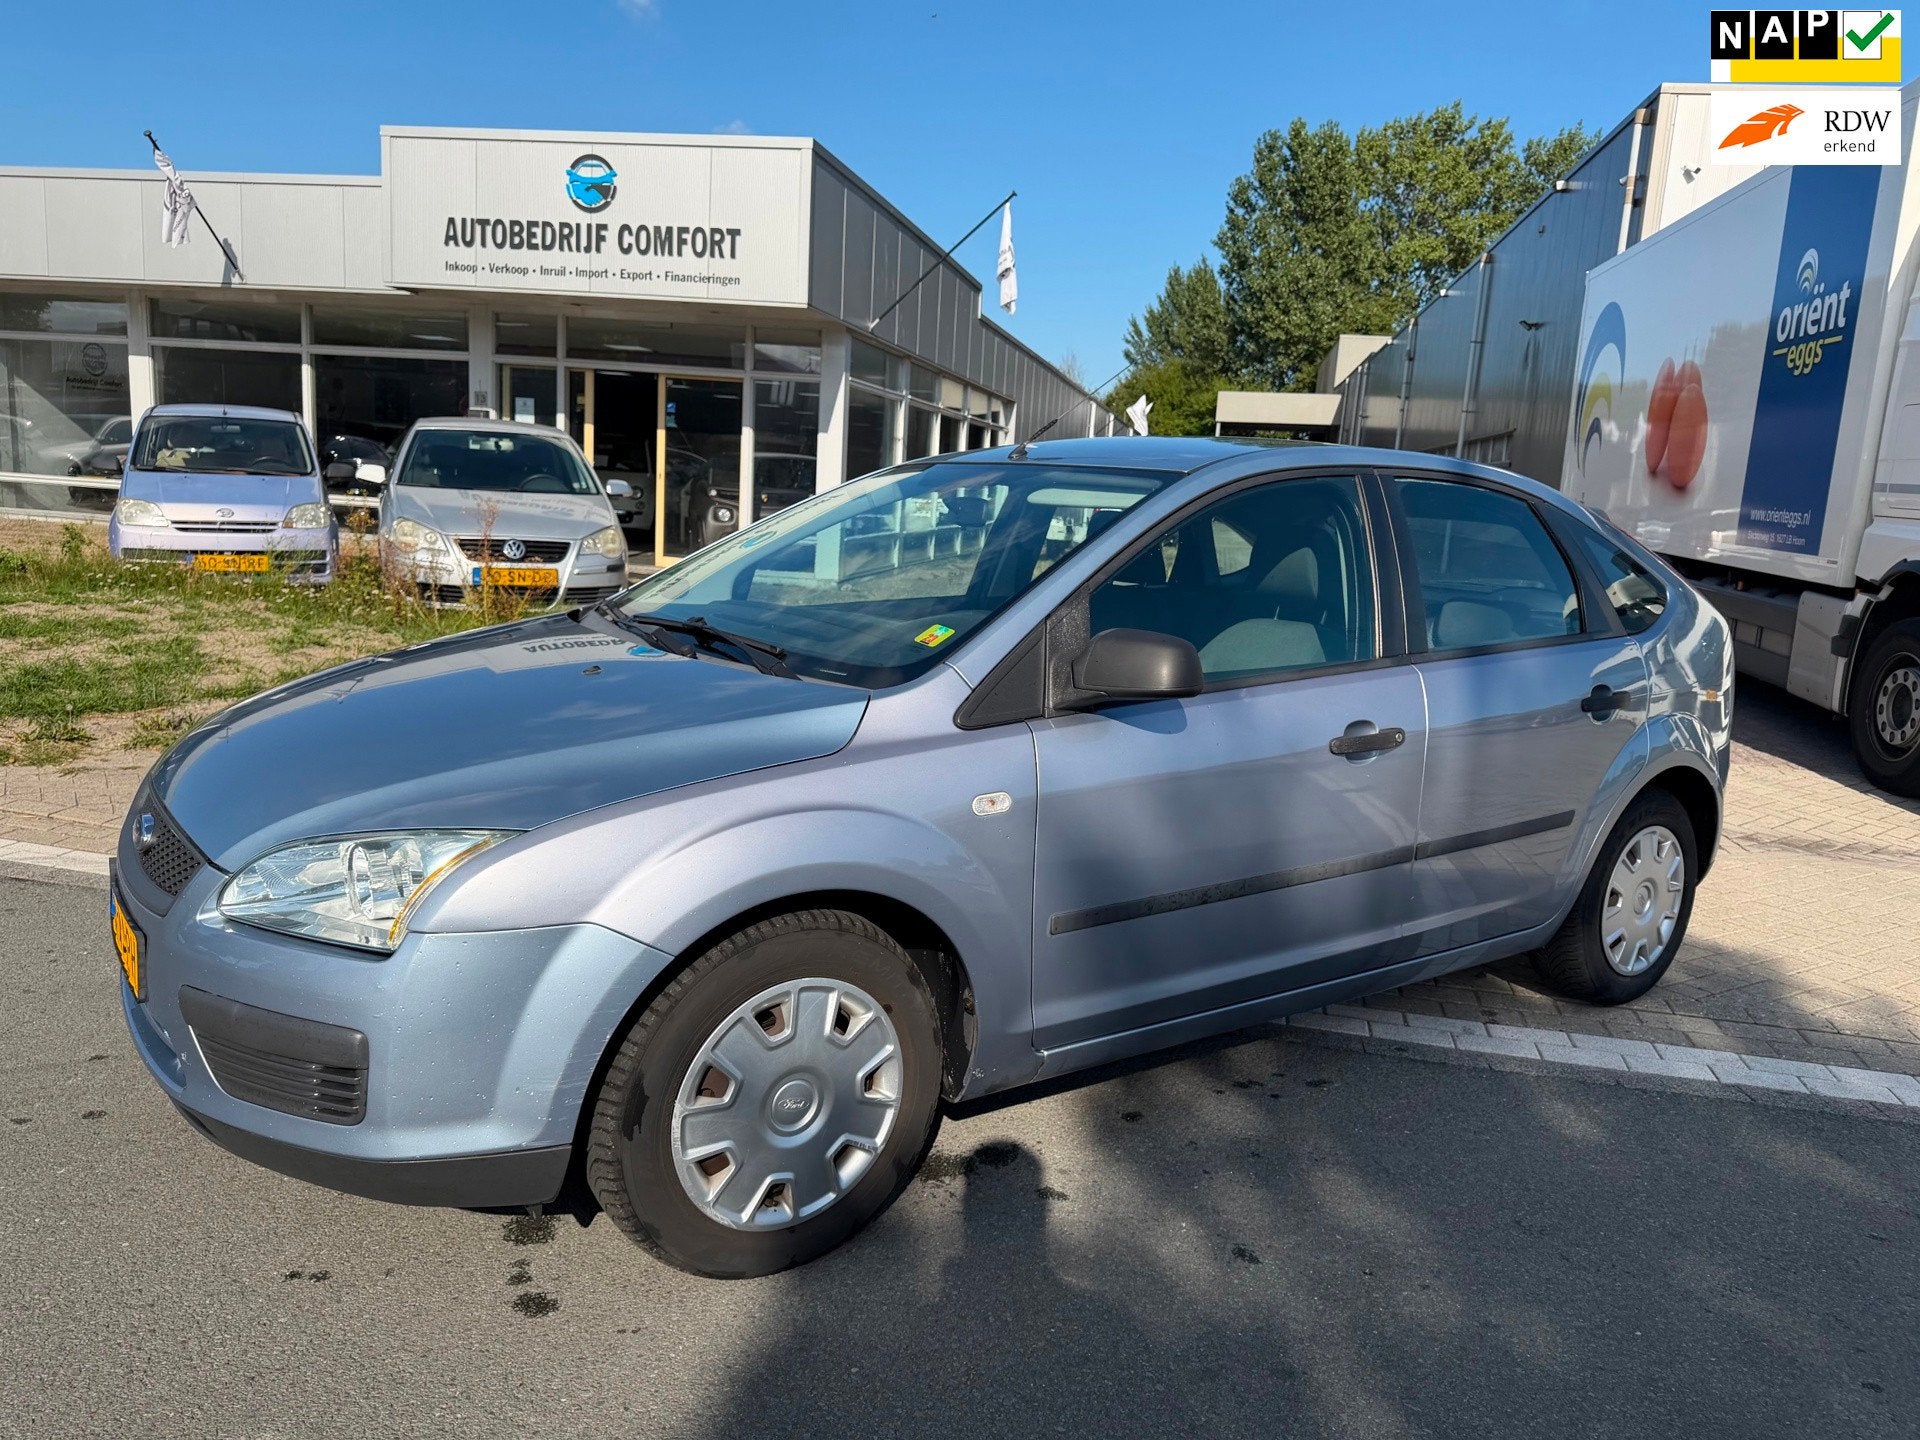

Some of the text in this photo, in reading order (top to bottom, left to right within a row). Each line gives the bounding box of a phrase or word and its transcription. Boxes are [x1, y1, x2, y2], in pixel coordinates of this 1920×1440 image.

[444, 217, 741, 259] AUTOBEDRIJF COMFORT
[445, 261, 740, 287] Inkoop Verkoop Inruil Import Export Financieringen
[1777, 280, 1851, 342] oriënt
[1787, 339, 1823, 376] eggs
[783, 1099, 805, 1110] Ford
